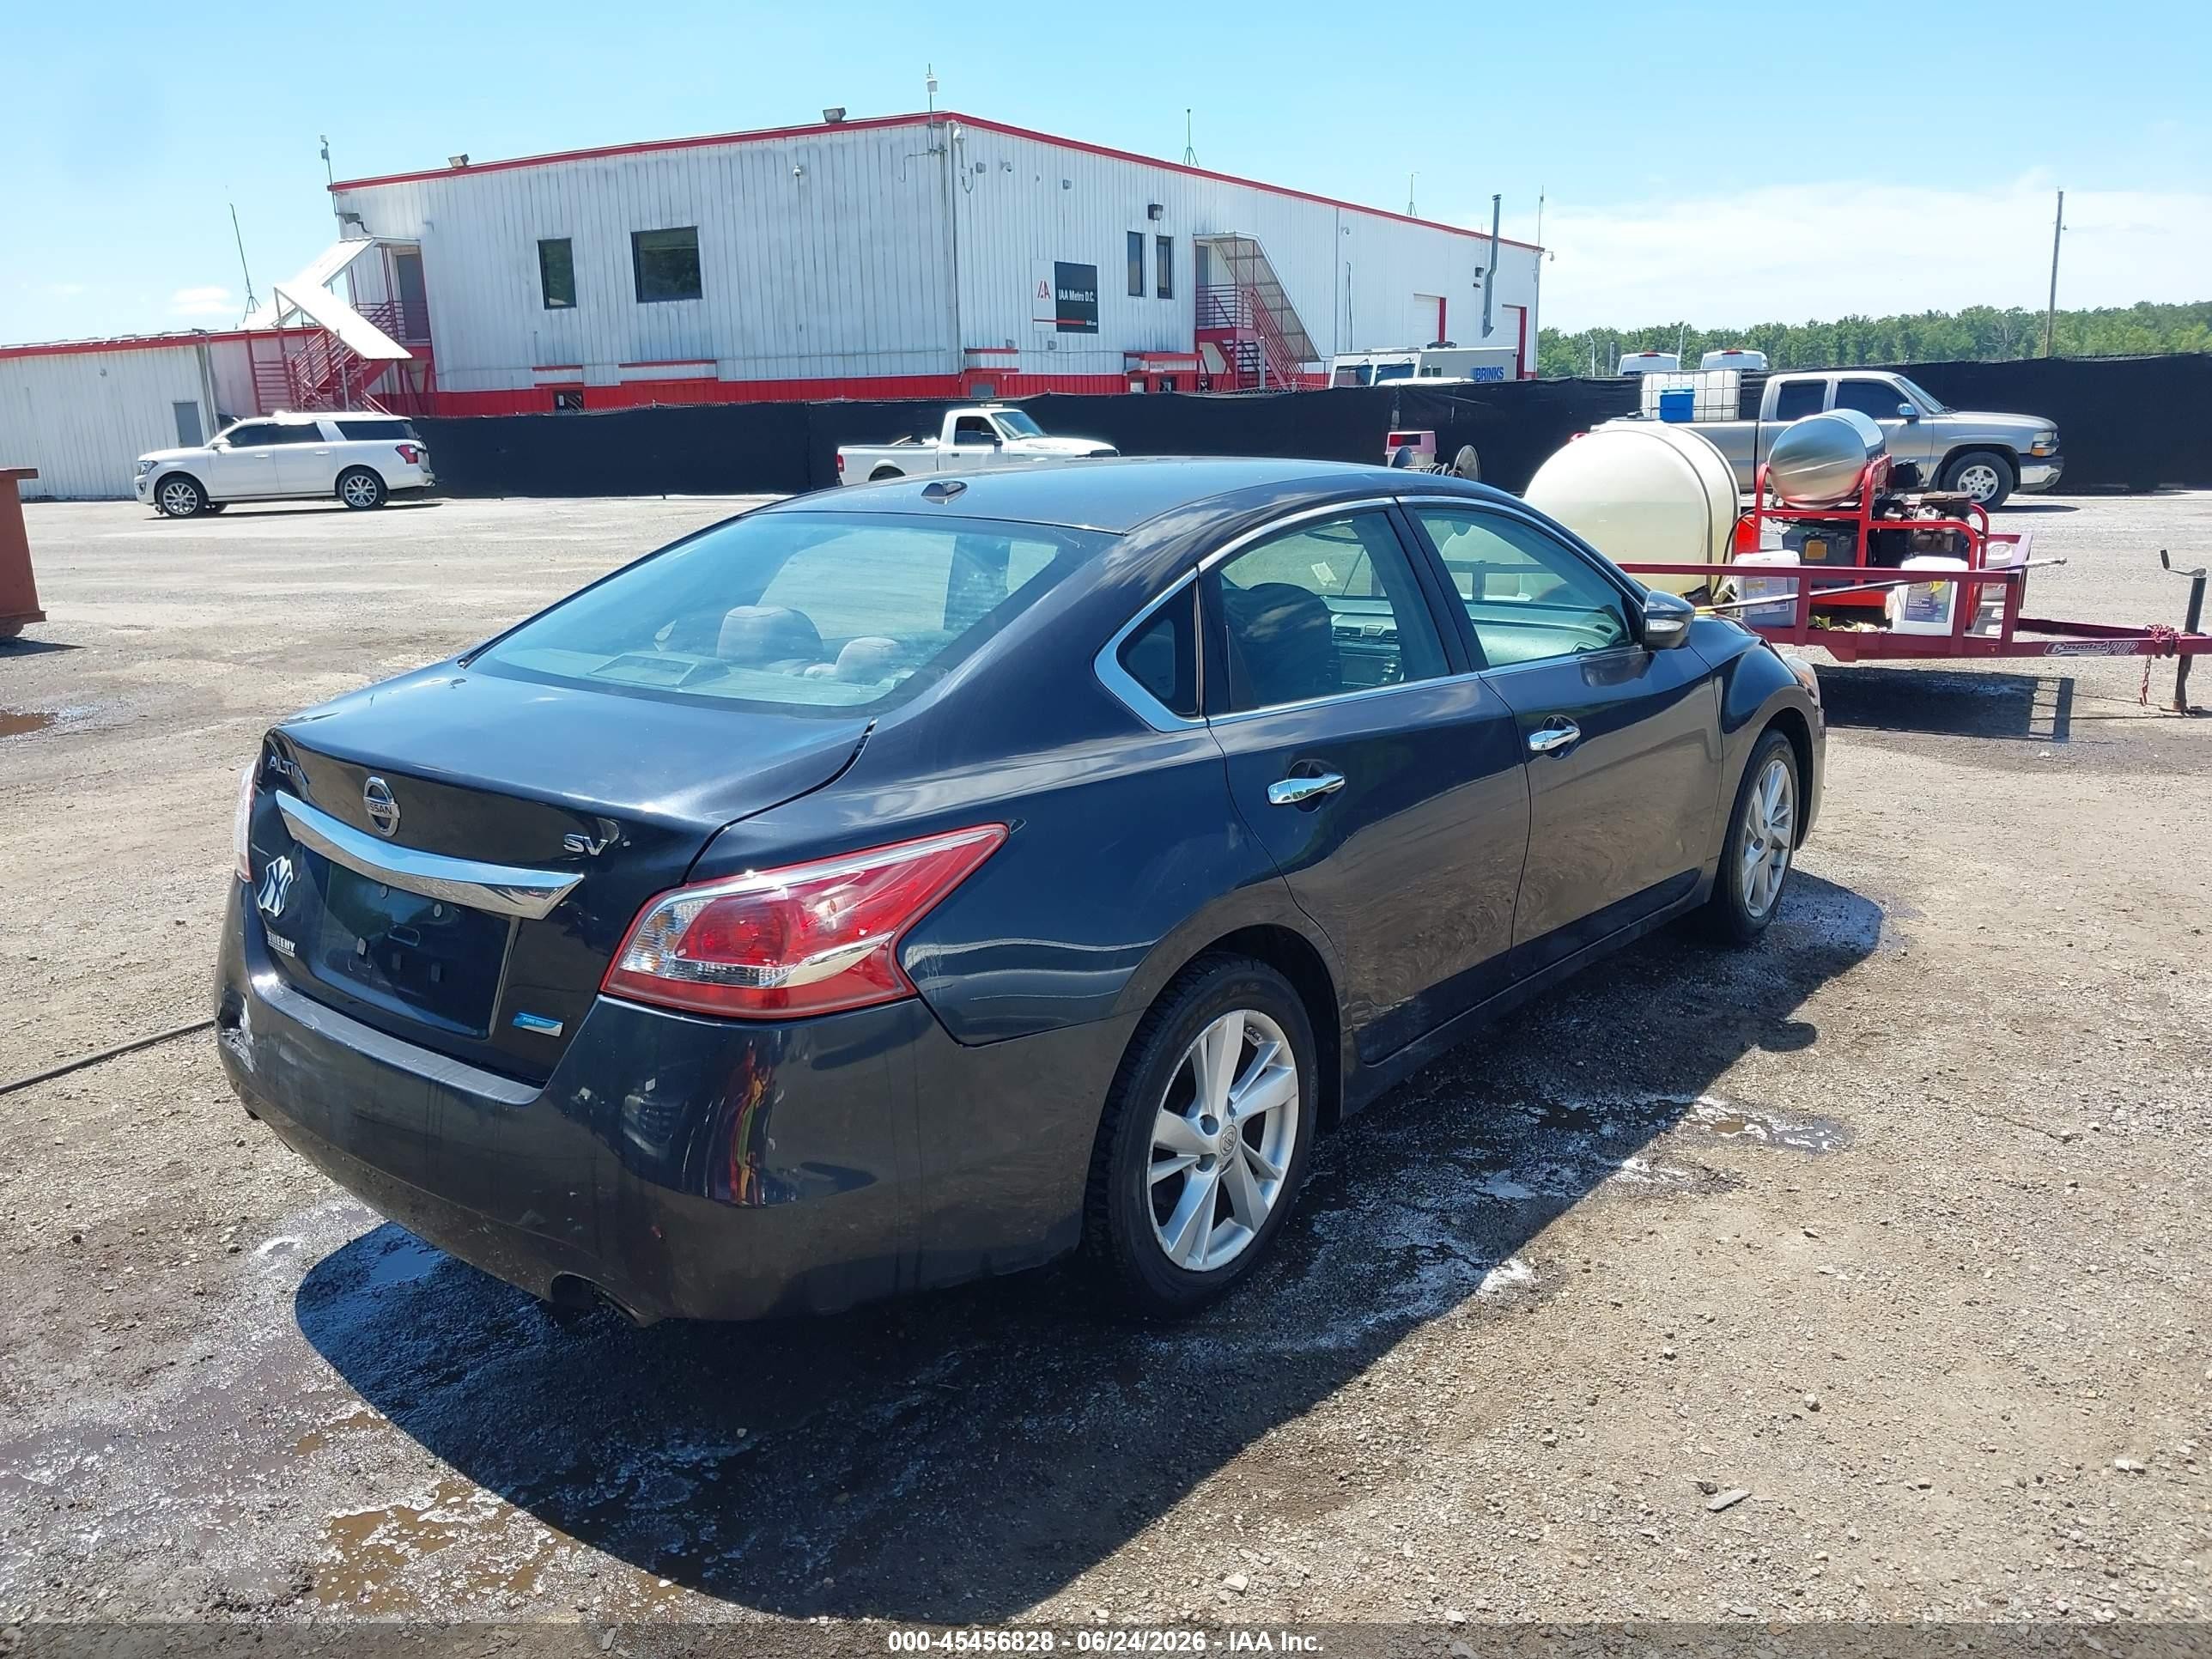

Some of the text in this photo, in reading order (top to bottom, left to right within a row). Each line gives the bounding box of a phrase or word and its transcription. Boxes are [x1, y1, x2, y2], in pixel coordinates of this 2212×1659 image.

[1058, 289, 1069, 301] IAA
[1069, 290, 1085, 301] Metro
[1475, 366, 1504, 381] BRINKS
[267, 756, 301, 778] ALTI
[563, 834, 609, 856] SV
[267, 931, 295, 952] SHEEHY
